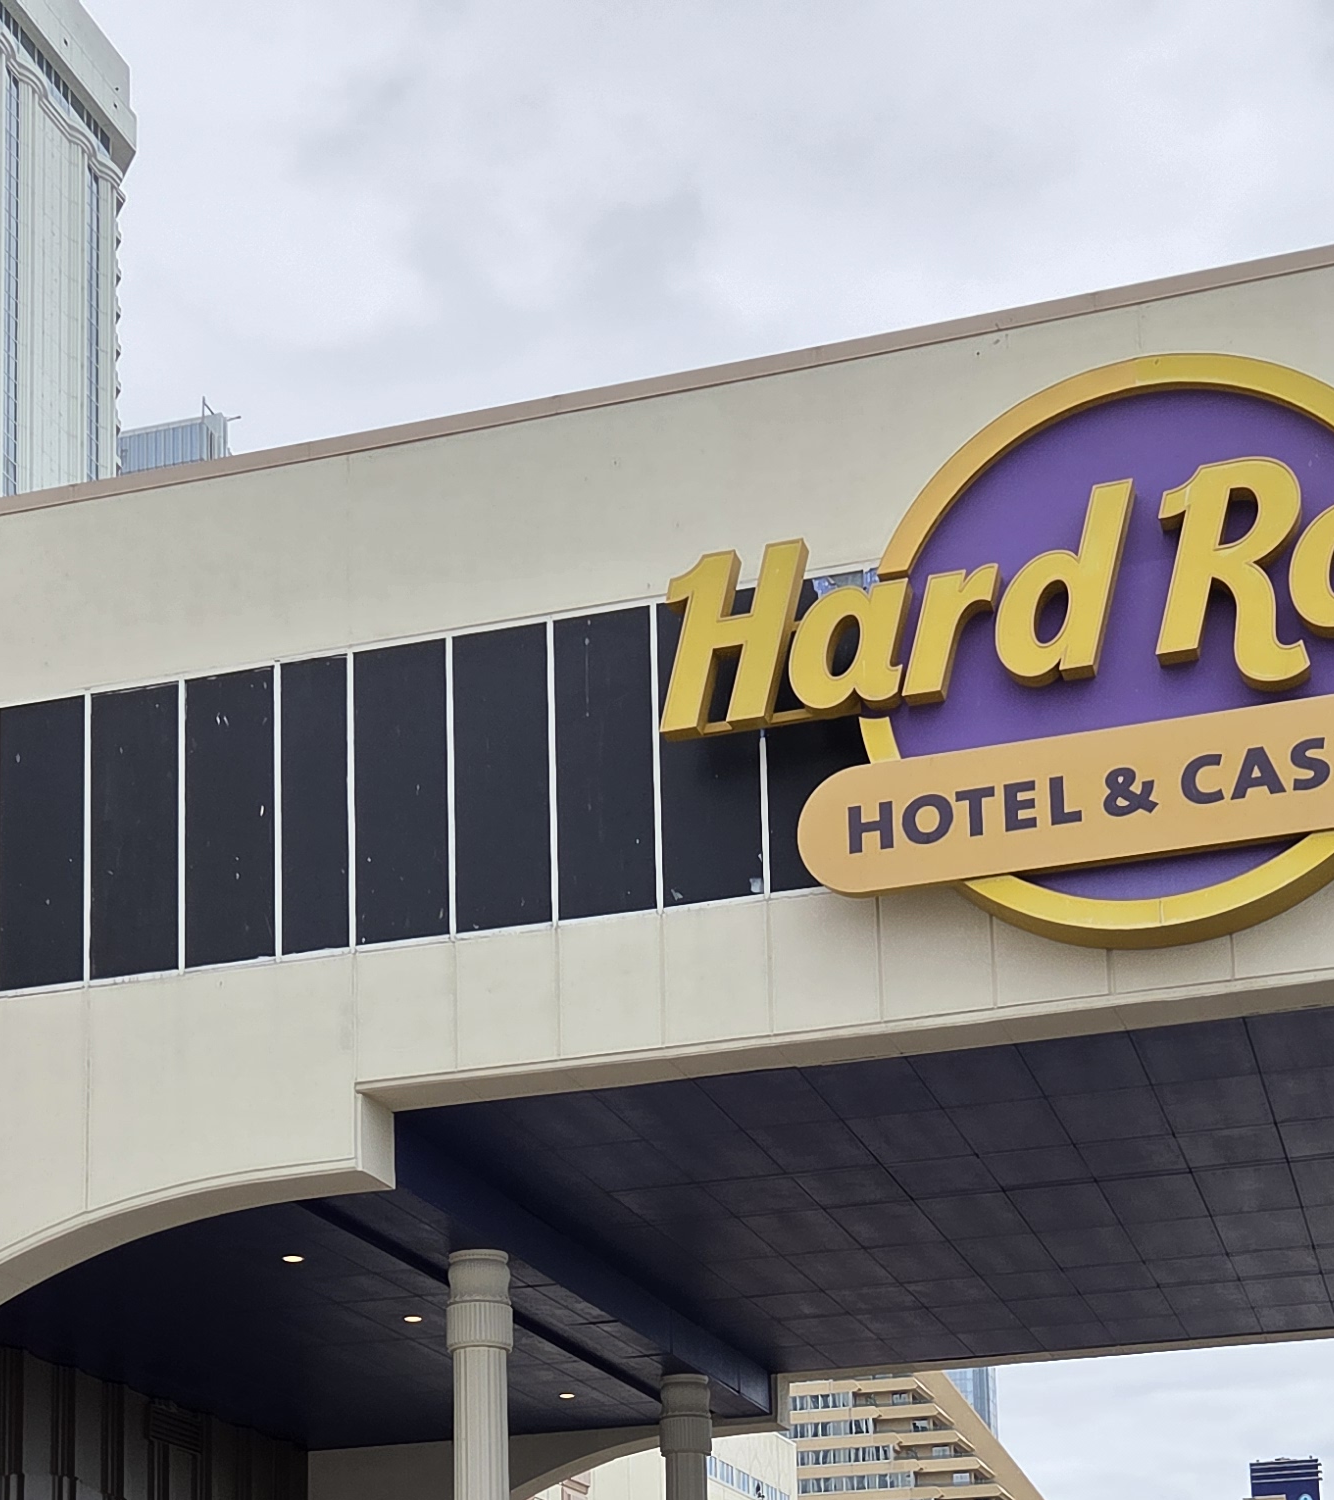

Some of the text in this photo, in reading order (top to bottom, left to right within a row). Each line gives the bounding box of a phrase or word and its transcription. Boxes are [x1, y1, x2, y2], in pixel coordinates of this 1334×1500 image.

[660, 478, 1137, 740] Hard
[847, 775, 1084, 856] HOTEL
[1103, 765, 1157, 819] &
